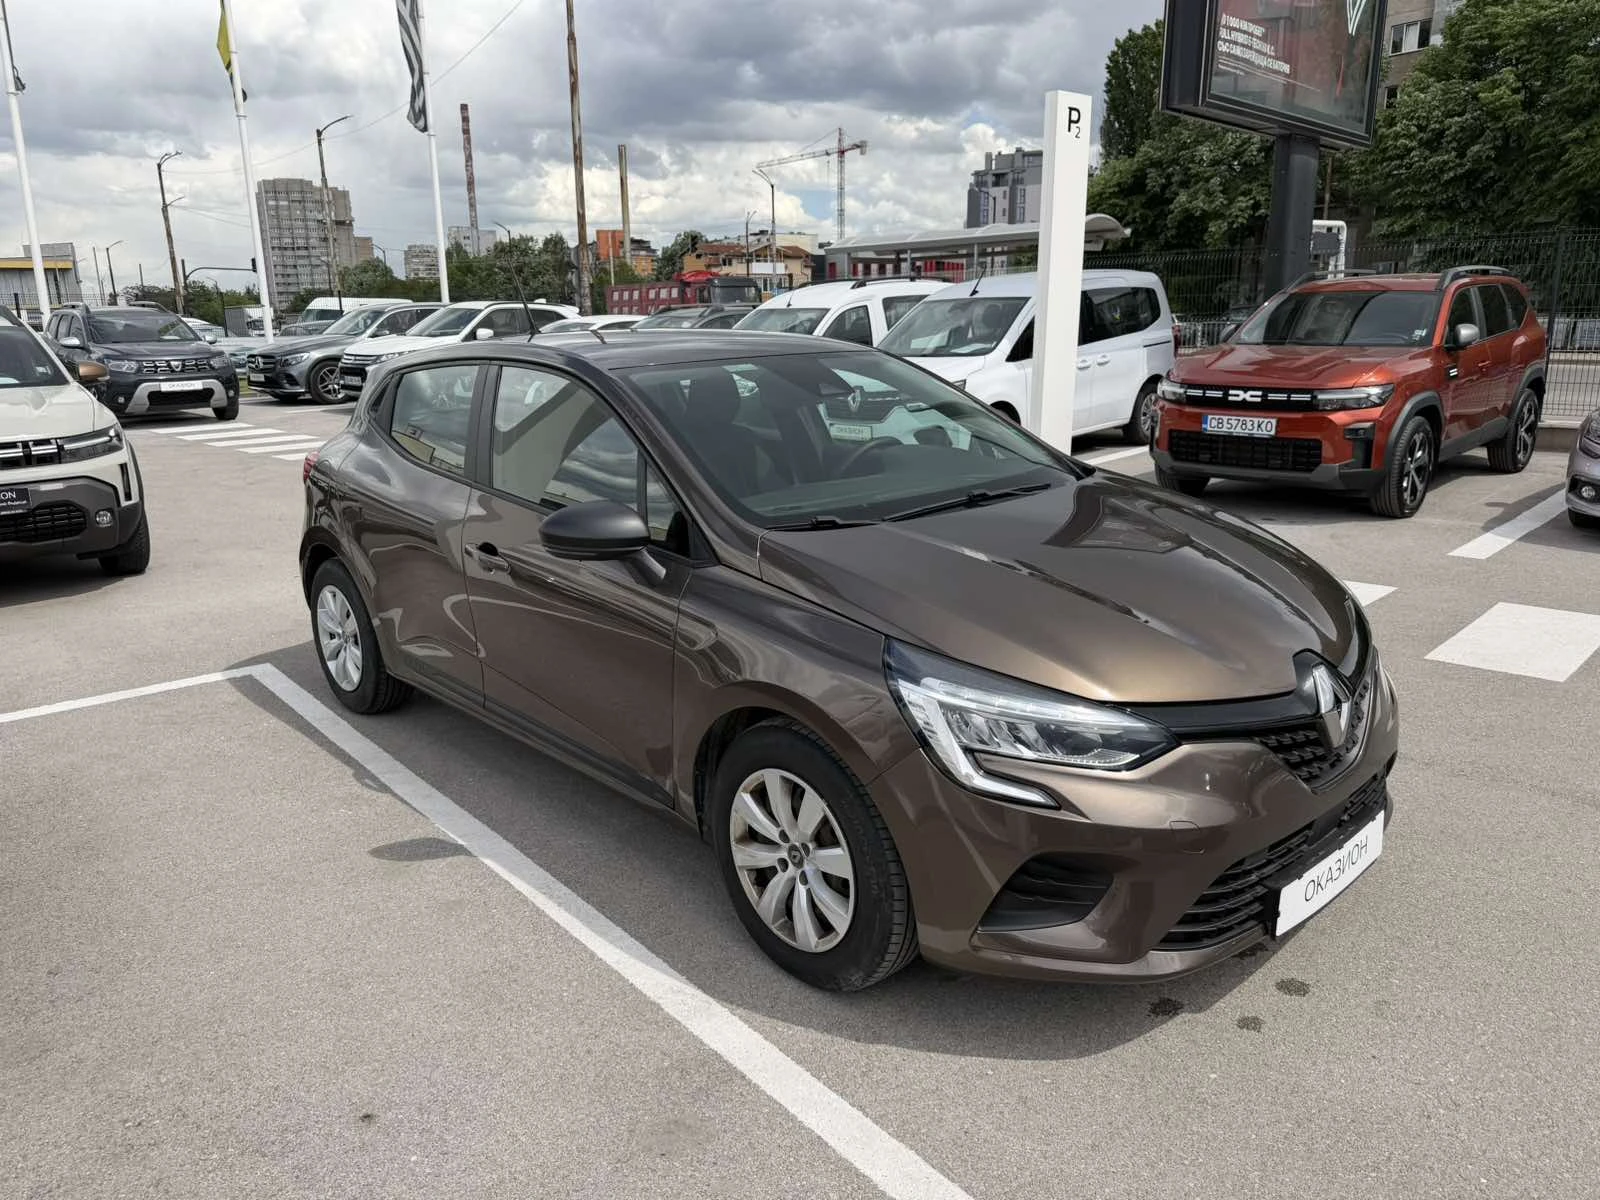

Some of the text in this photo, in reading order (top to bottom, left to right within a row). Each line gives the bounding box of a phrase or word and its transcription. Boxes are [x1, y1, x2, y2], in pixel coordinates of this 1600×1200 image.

[1209, 417, 1224, 430] CB
[1226, 418, 1256, 432] 5783
[1304, 835, 1368, 902] ОКАЗИОН
